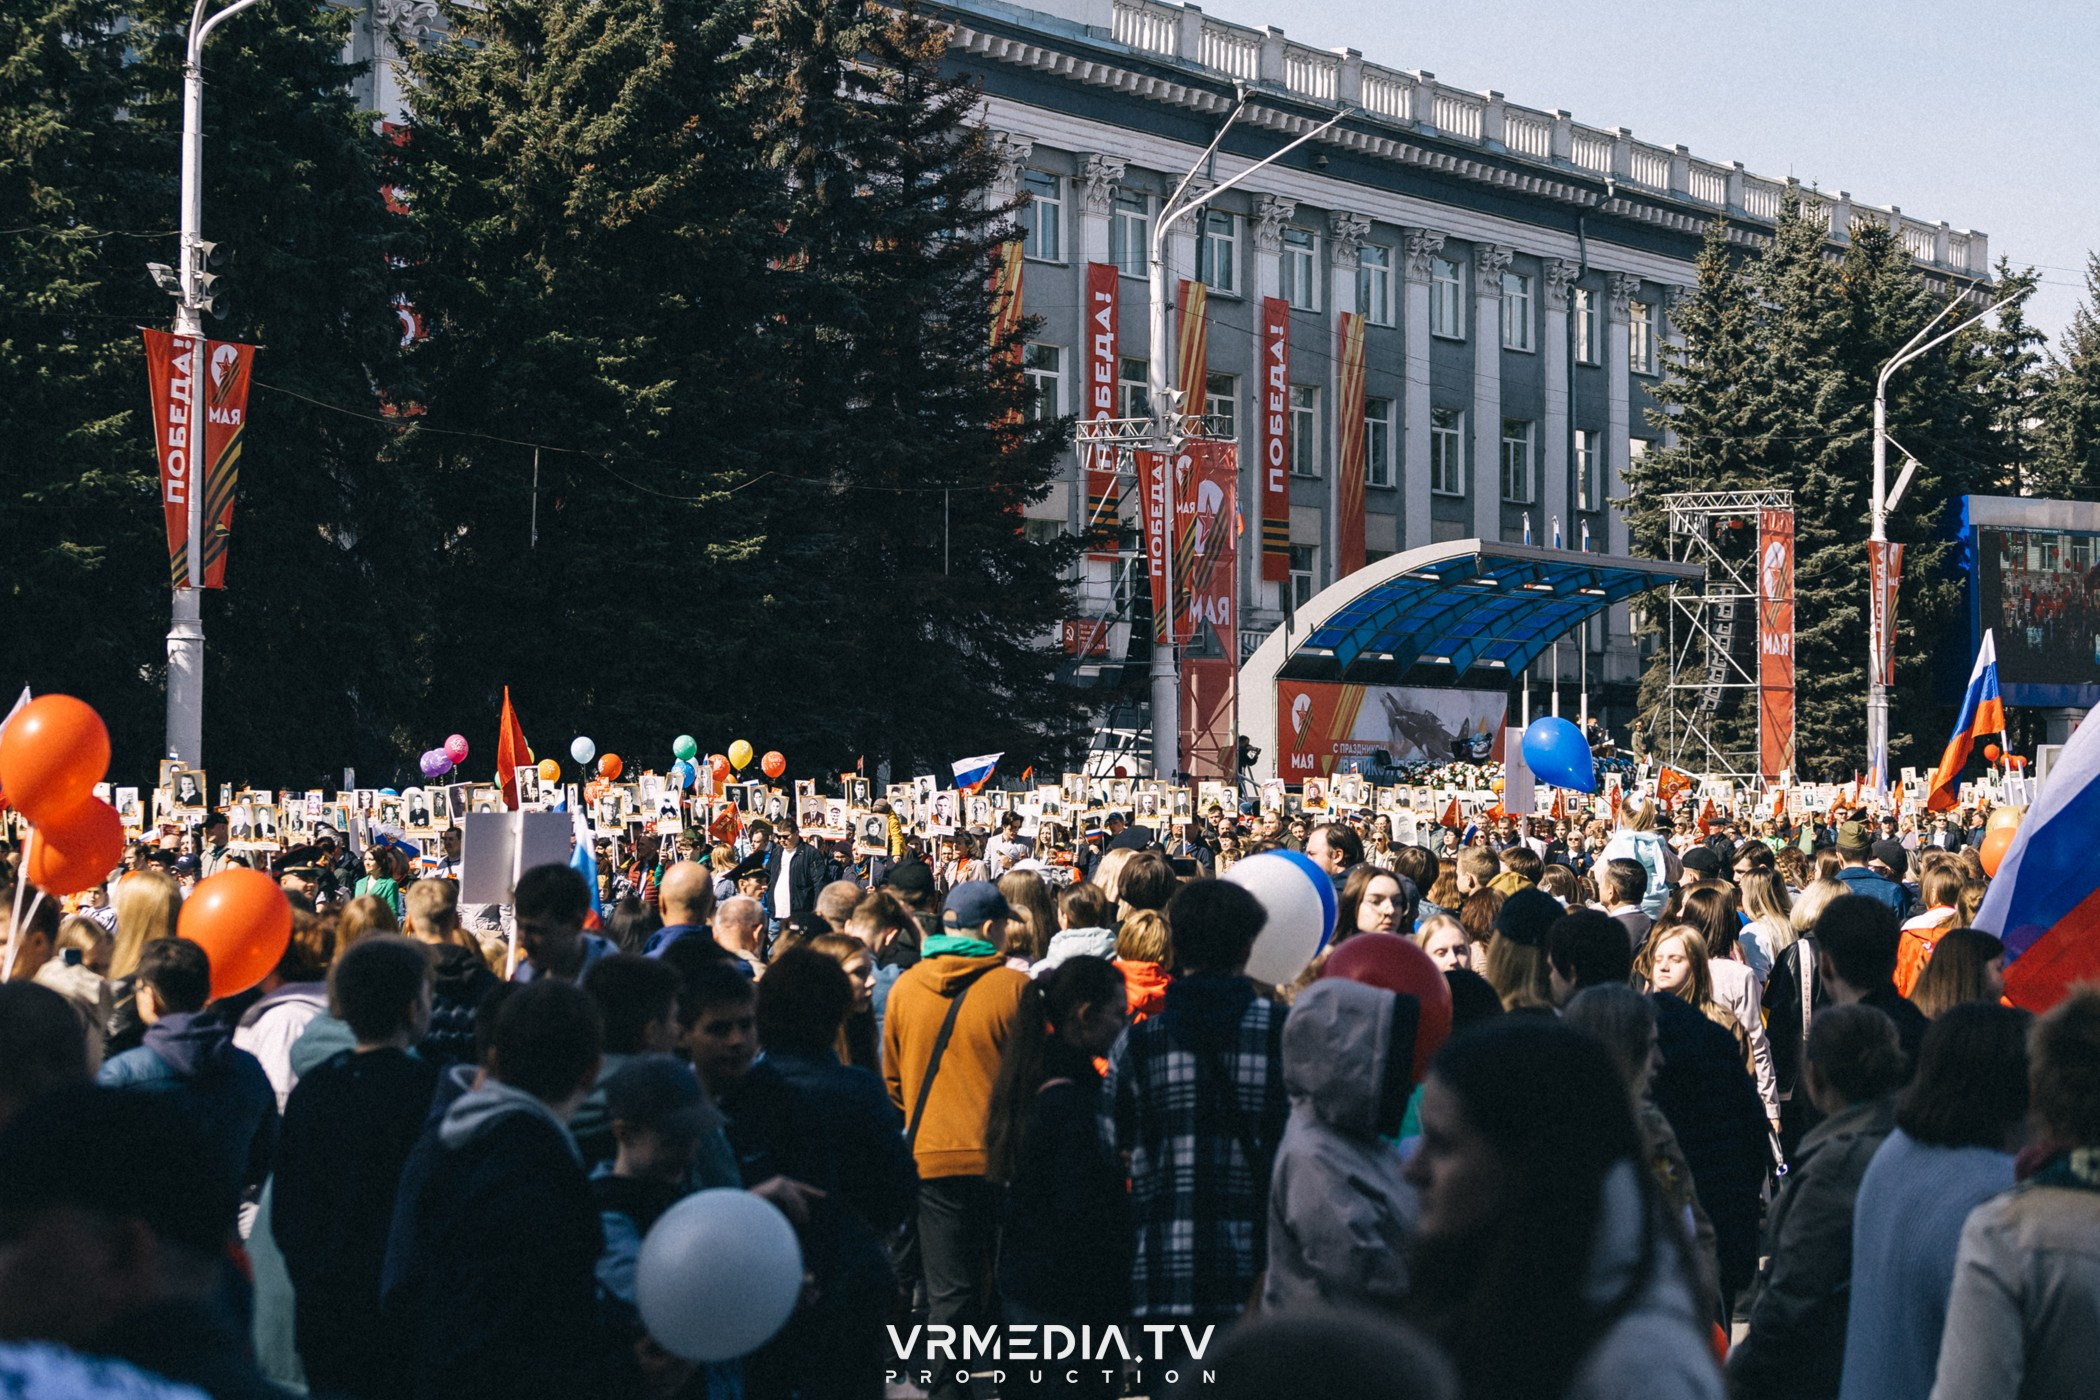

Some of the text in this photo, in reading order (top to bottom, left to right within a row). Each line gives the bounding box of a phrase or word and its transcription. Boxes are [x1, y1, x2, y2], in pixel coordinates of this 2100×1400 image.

[167, 338, 192, 504] ПОБЕДА!
[209, 406, 240, 425] МАЯ
[1269, 325, 1286, 493] ПОБЕДА!
[1151, 455, 1164, 577] ПОБЕДА!
[1176, 501, 1195, 514] МАЯ
[1189, 594, 1230, 625] МАЯ
[1763, 631, 1789, 656] МАЯ
[1291, 753, 1314, 769] МАЯ
